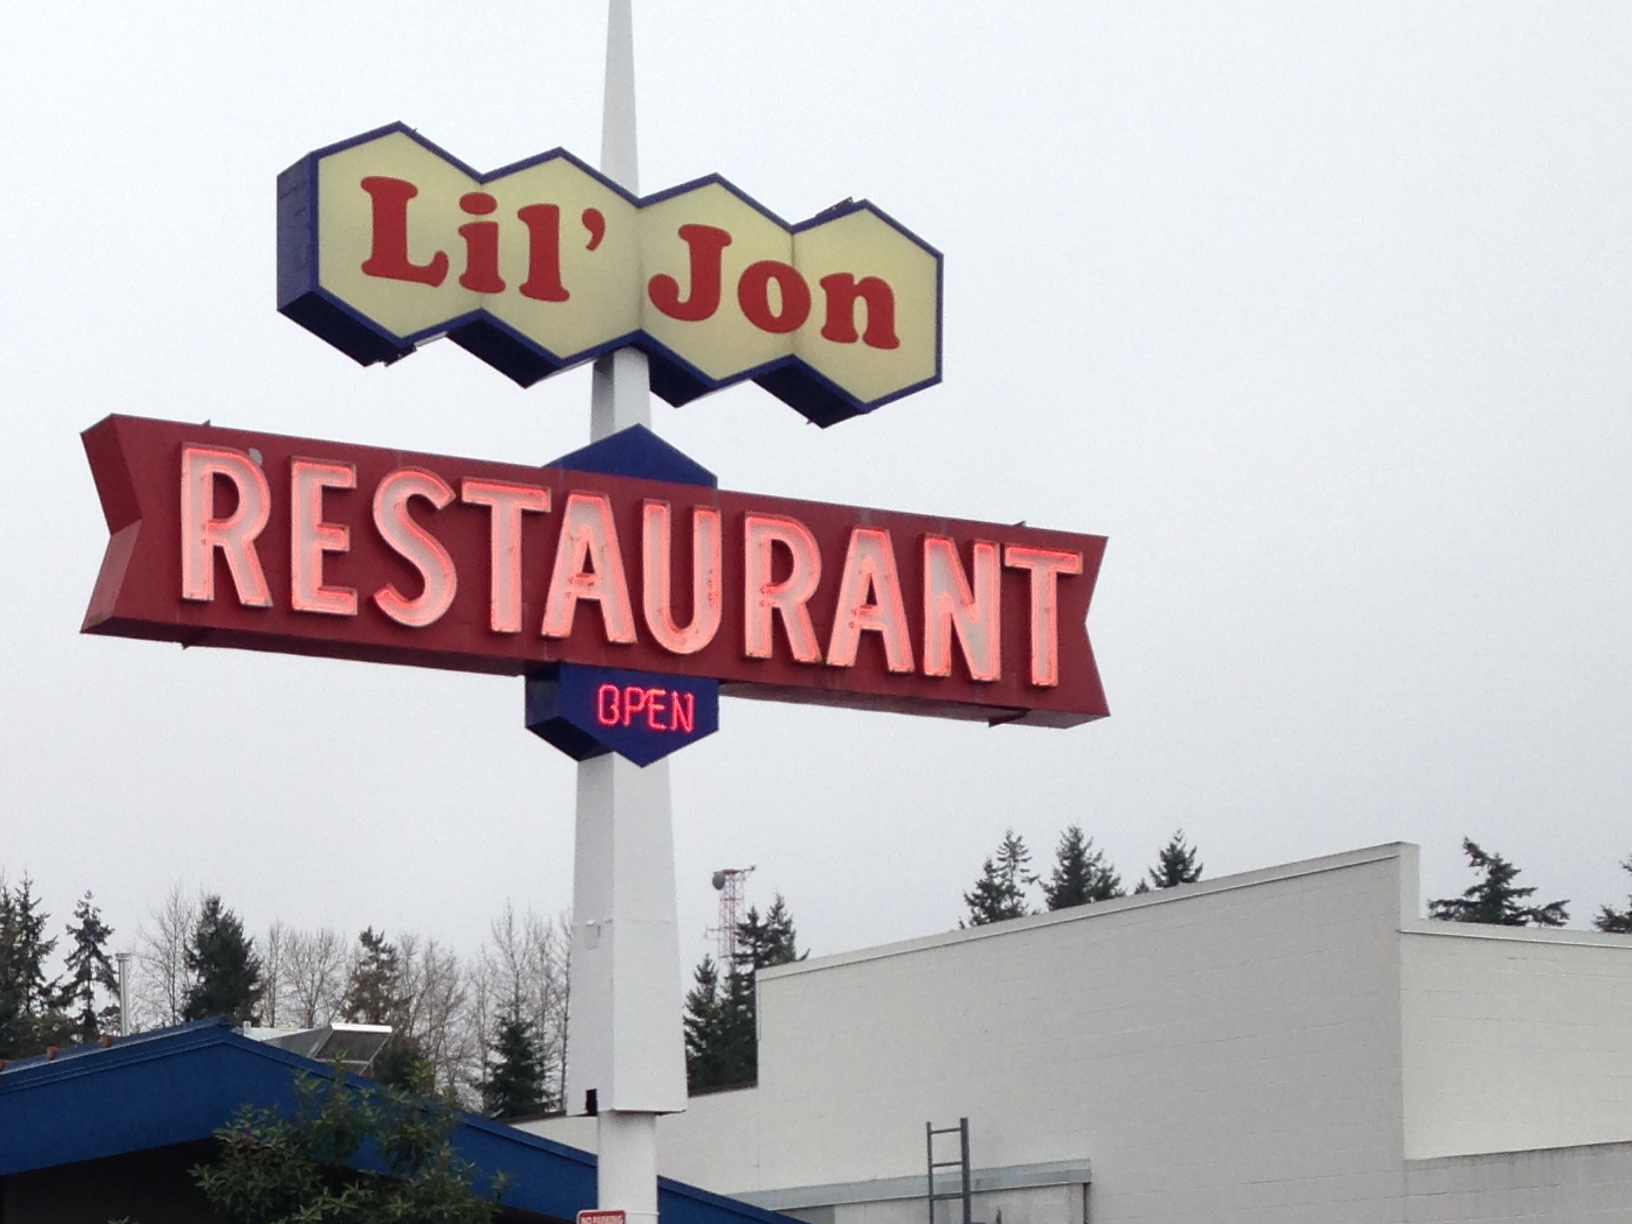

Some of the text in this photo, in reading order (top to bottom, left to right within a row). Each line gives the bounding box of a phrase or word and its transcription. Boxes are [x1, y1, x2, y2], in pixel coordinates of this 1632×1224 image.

[360, 175, 900, 350] Lil' Jon
[181, 442, 1083, 688] RESTAURANT
[597, 682, 695, 733] OPEN
[580, 1215, 624, 1224] NO PARKING
